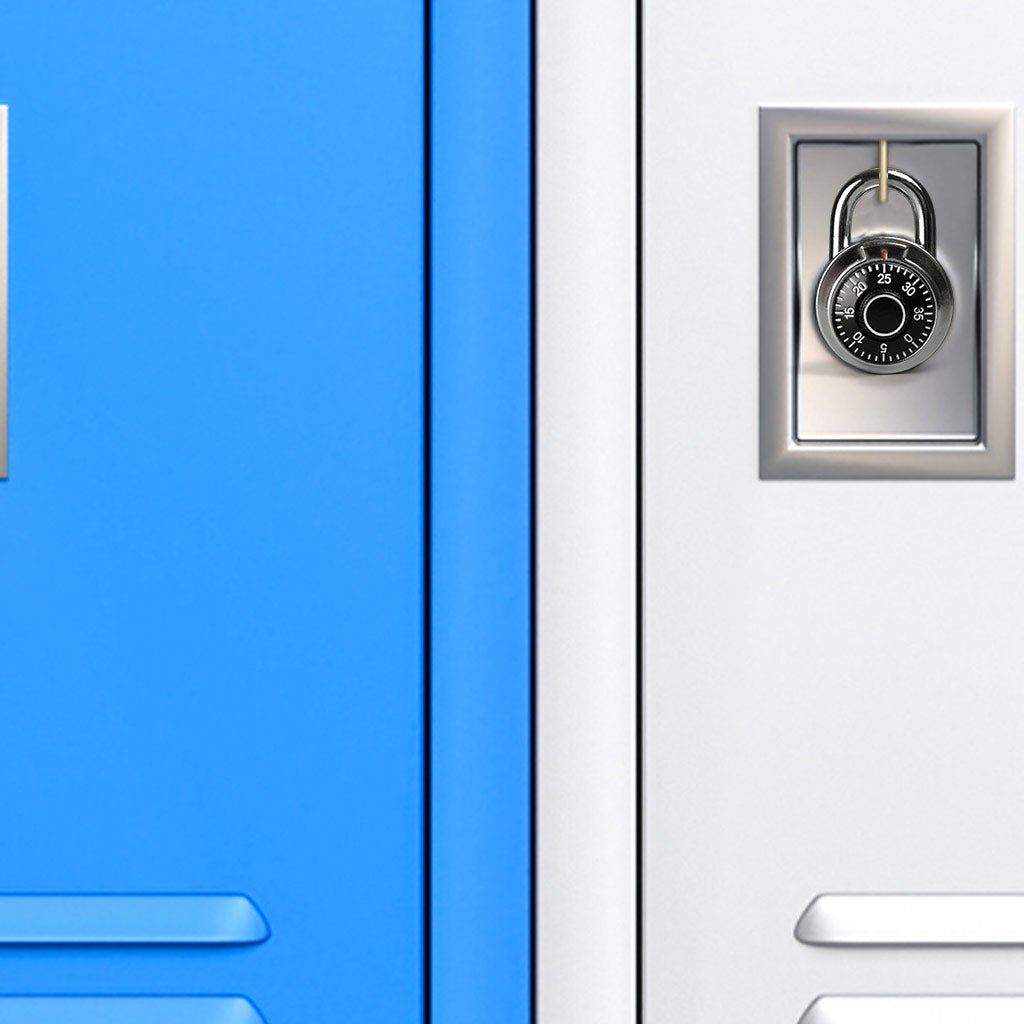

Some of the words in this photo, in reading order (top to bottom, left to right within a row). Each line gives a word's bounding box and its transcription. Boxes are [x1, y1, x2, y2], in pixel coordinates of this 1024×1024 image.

[877, 273, 892, 284] 25
[852, 281, 867, 297] 20
[901, 282, 916, 296] 30
[844, 307, 855, 320] 15
[913, 306, 924, 321] 35
[852, 331, 866, 344] 10
[880, 342, 888, 354] 5
